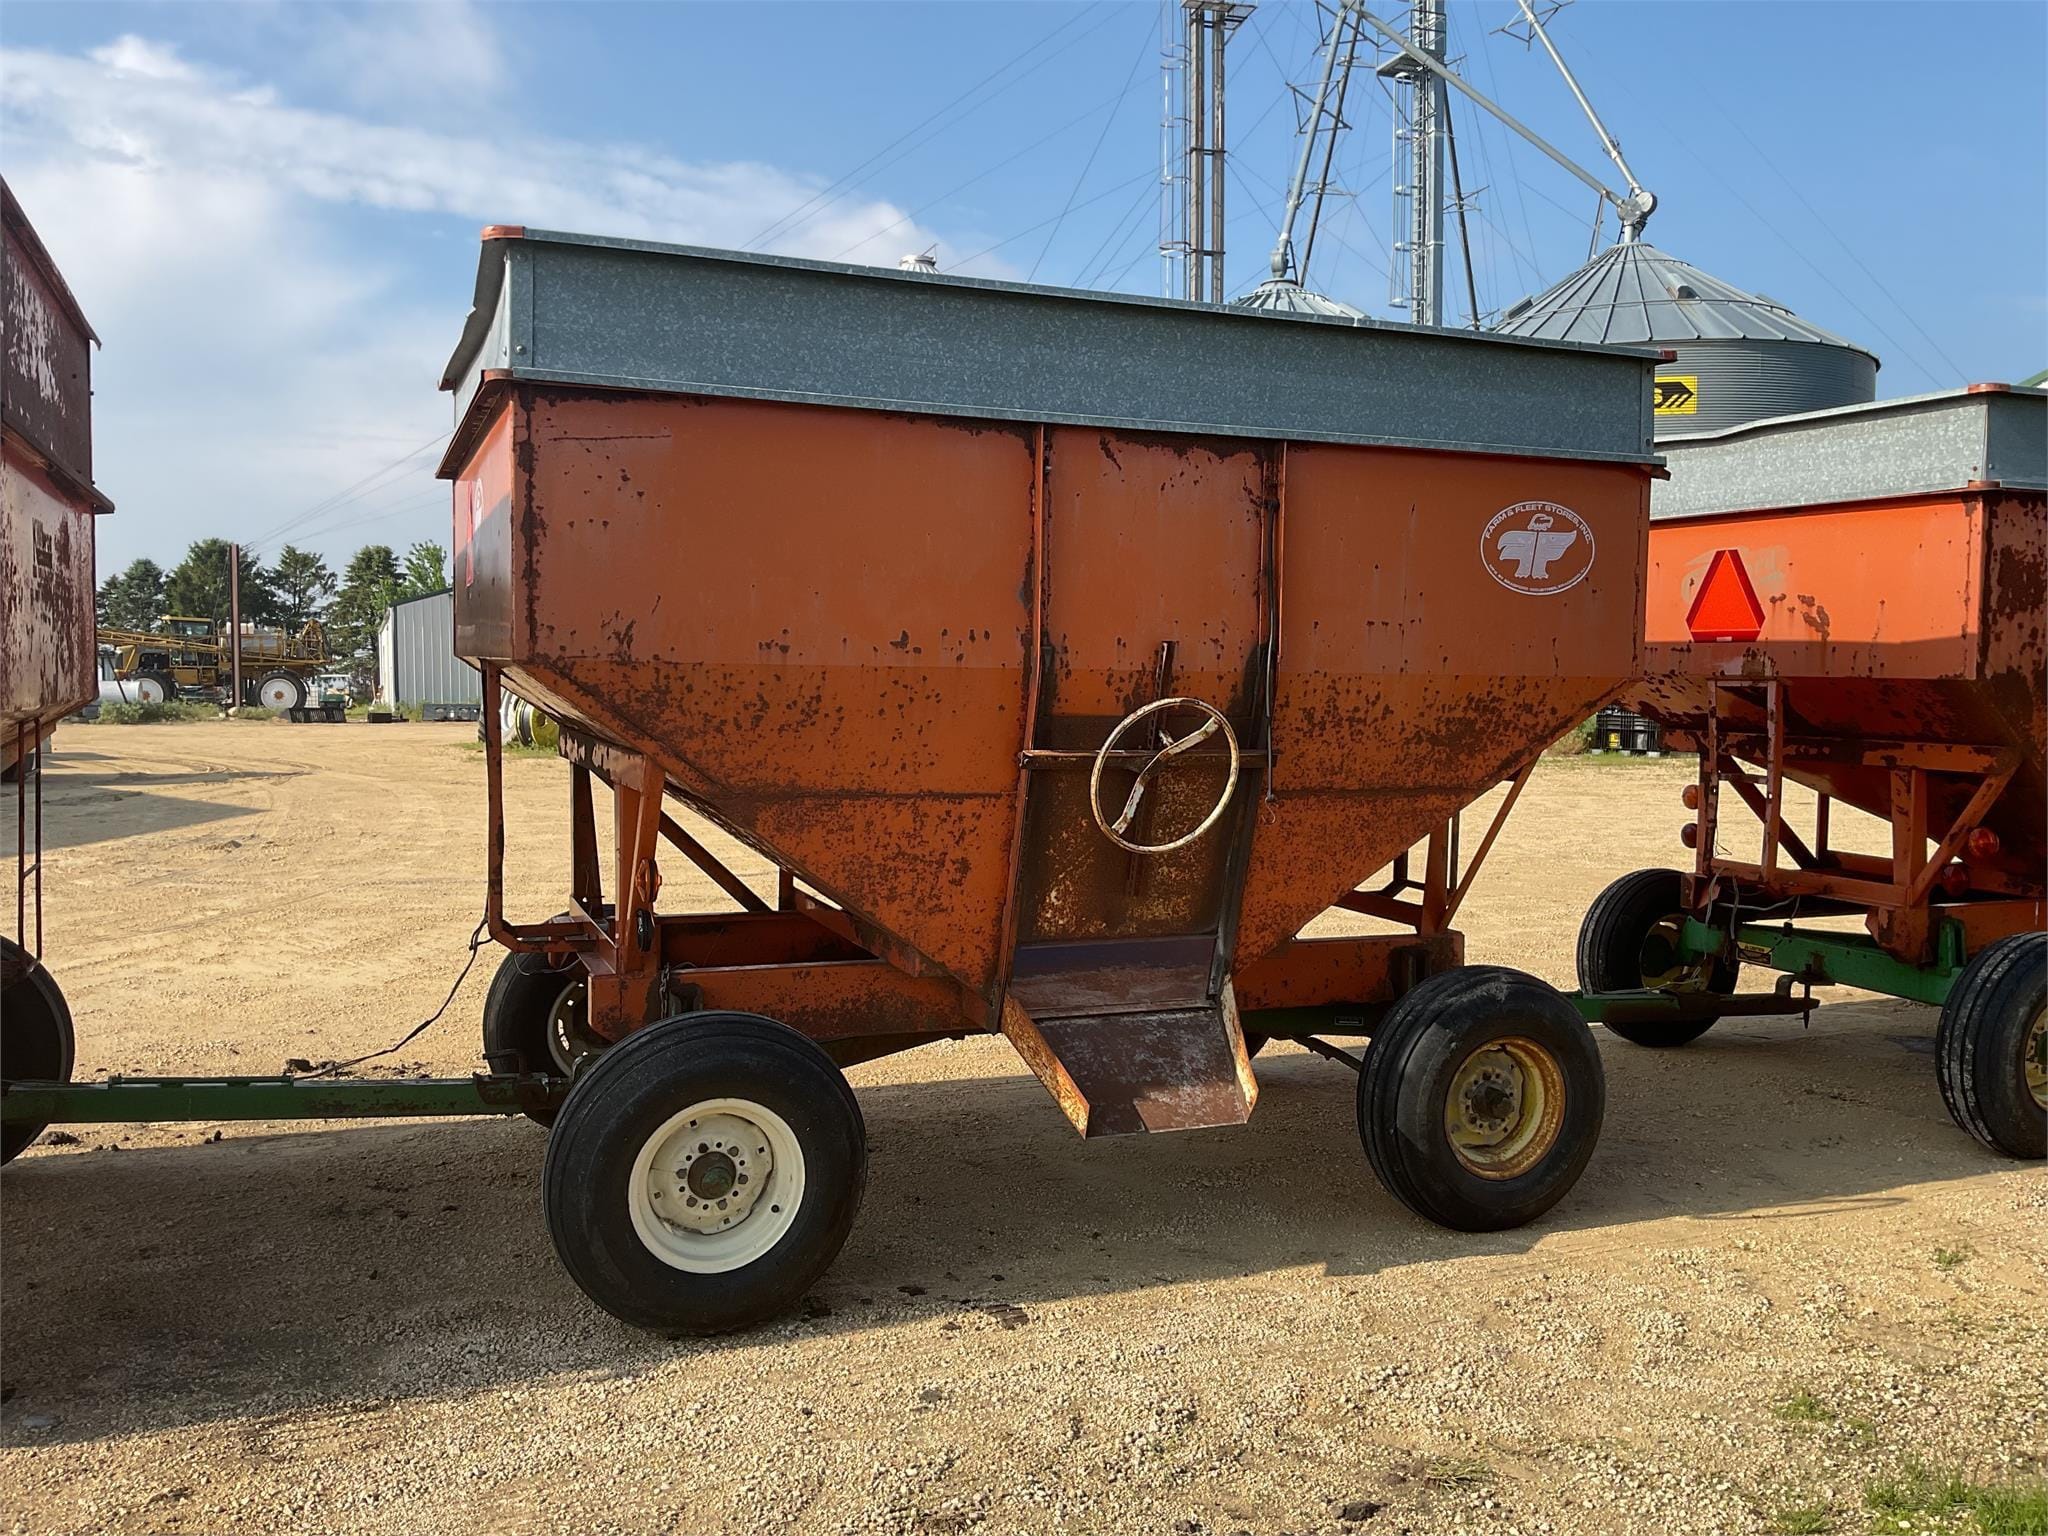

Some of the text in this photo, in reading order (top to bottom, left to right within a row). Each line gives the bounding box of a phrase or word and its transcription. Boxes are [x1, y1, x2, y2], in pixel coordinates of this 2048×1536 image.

[1485, 512, 1507, 539] FARM
[1507, 509, 1514, 517] &
[1515, 504, 1543, 513] FLEET
[1545, 505, 1580, 527] STORES,
